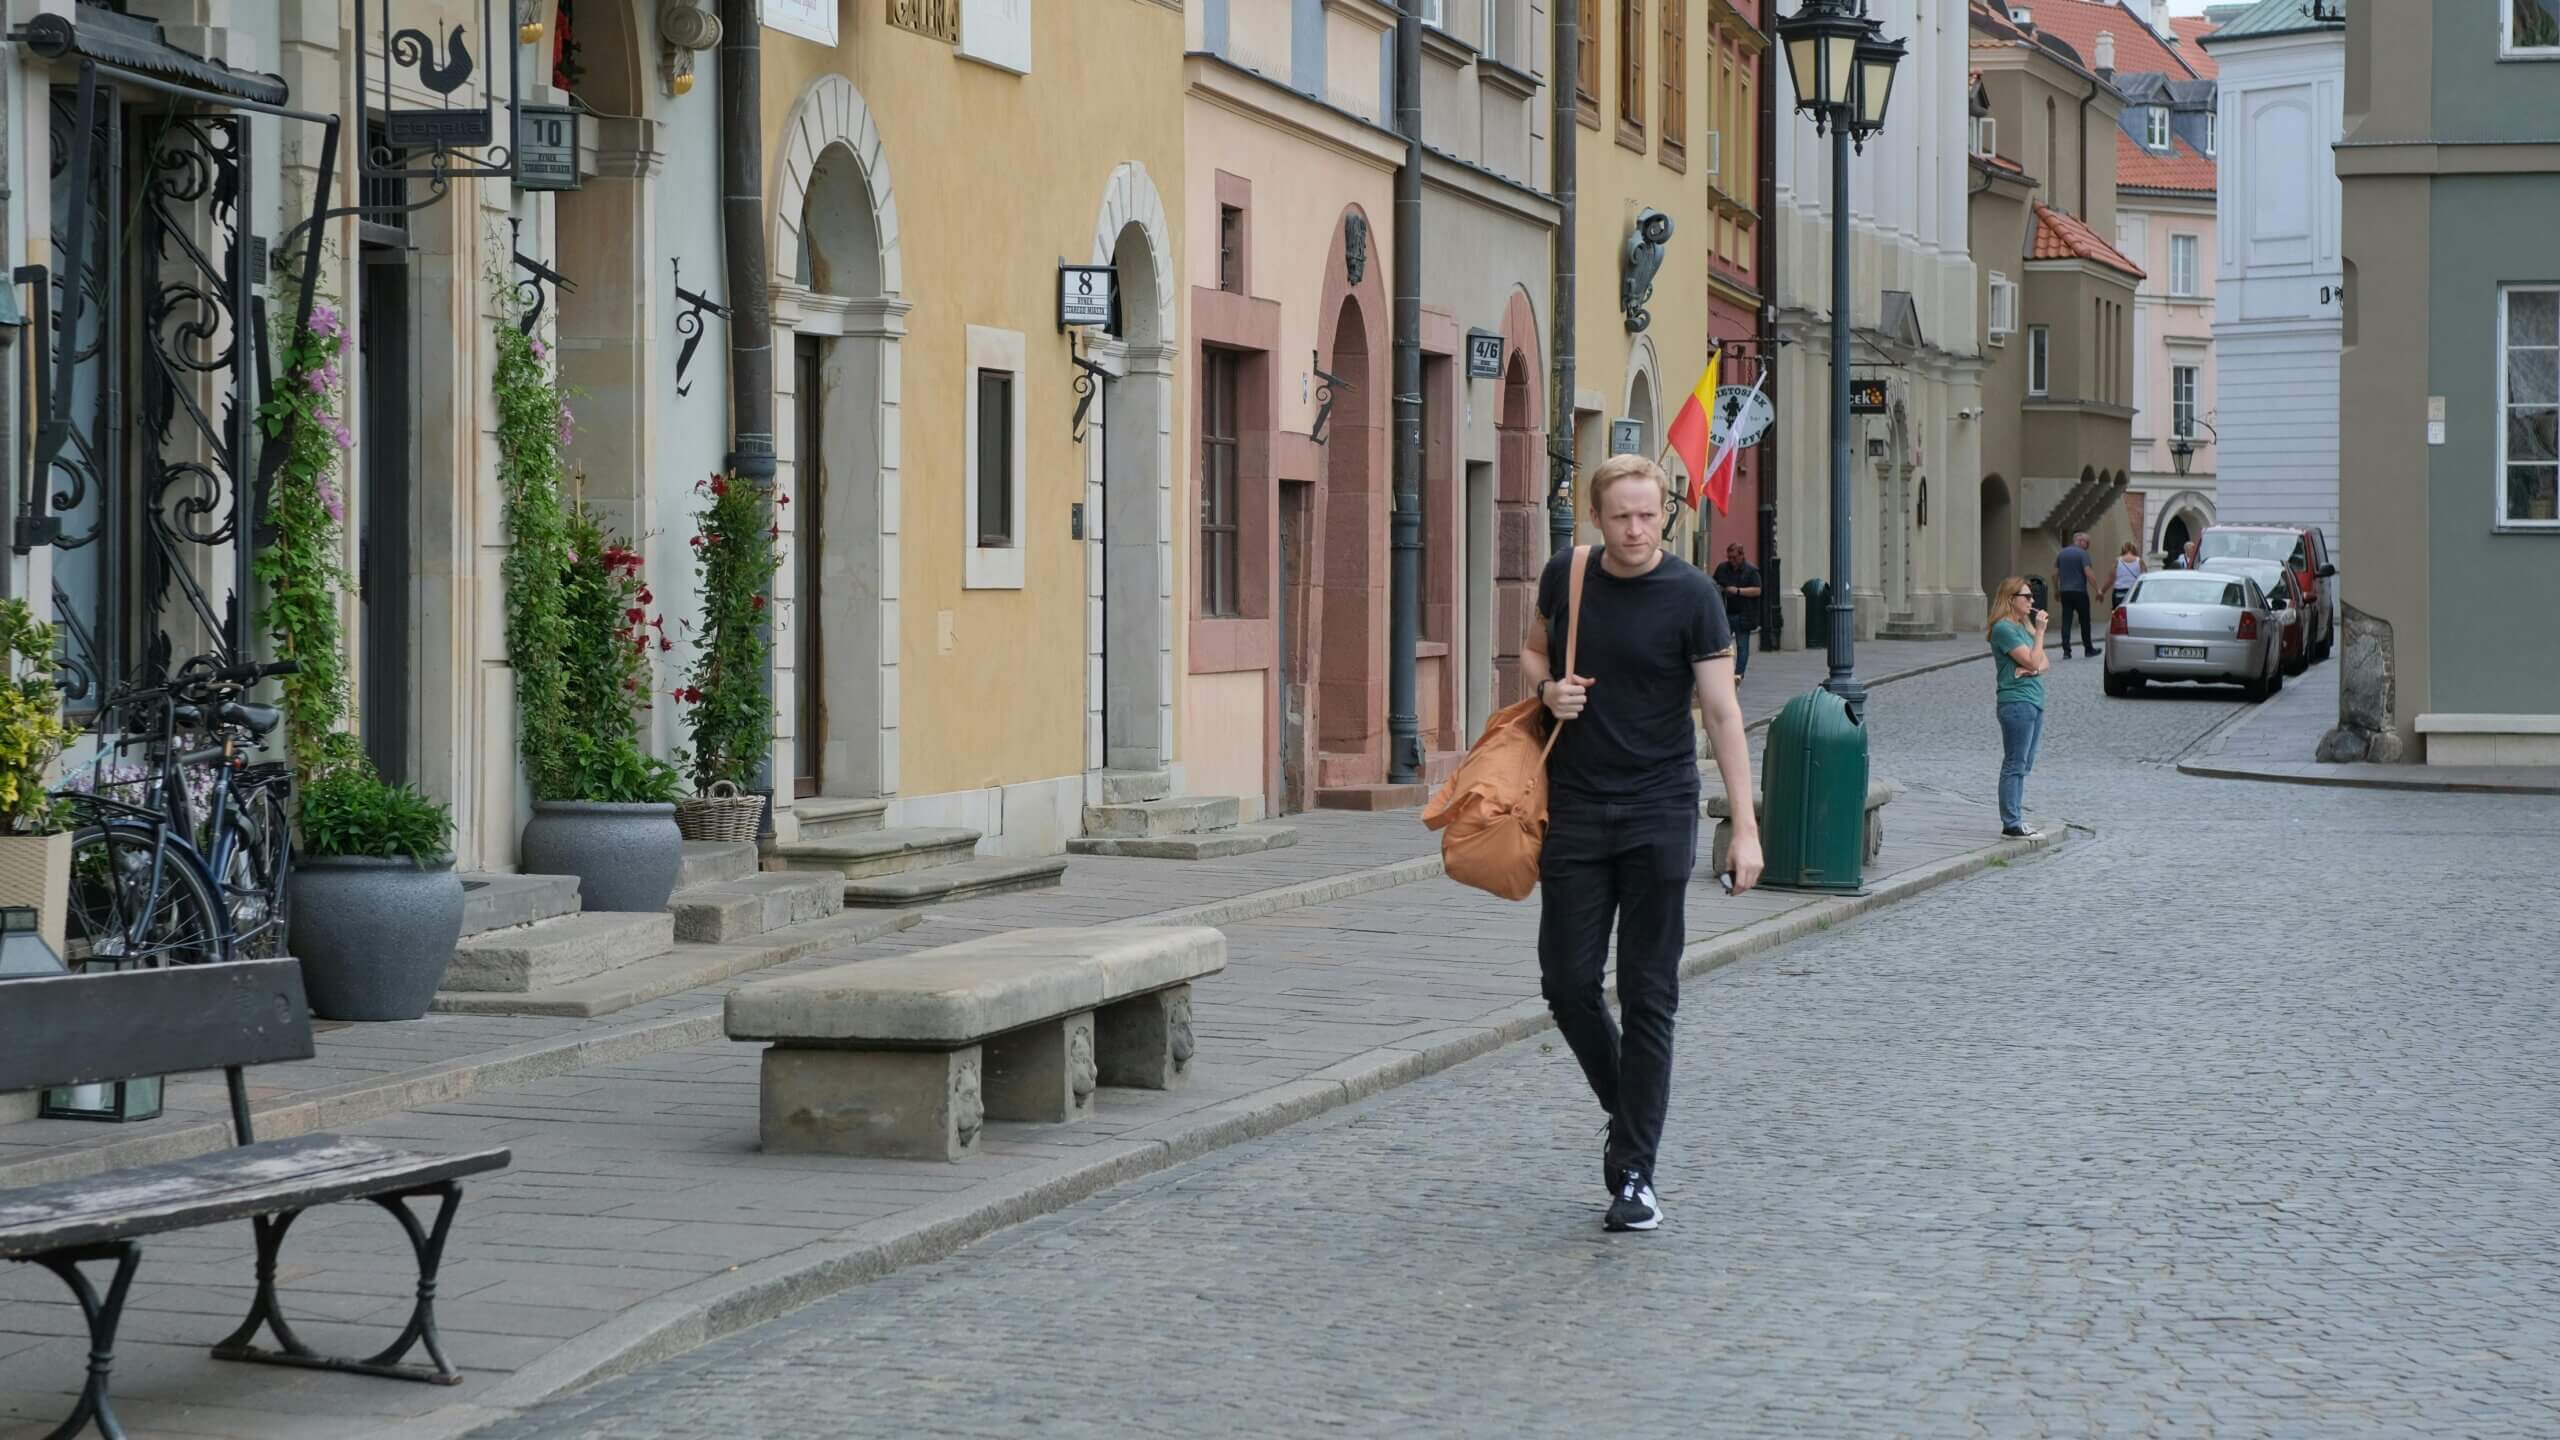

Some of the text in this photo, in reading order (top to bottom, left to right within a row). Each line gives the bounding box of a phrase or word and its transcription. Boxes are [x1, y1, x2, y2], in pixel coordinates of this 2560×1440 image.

[533, 119, 562, 147] 10
[1079, 271, 1092, 295] 8
[1475, 341, 1498, 358] 4/6
[1624, 427, 1632, 441] 2
